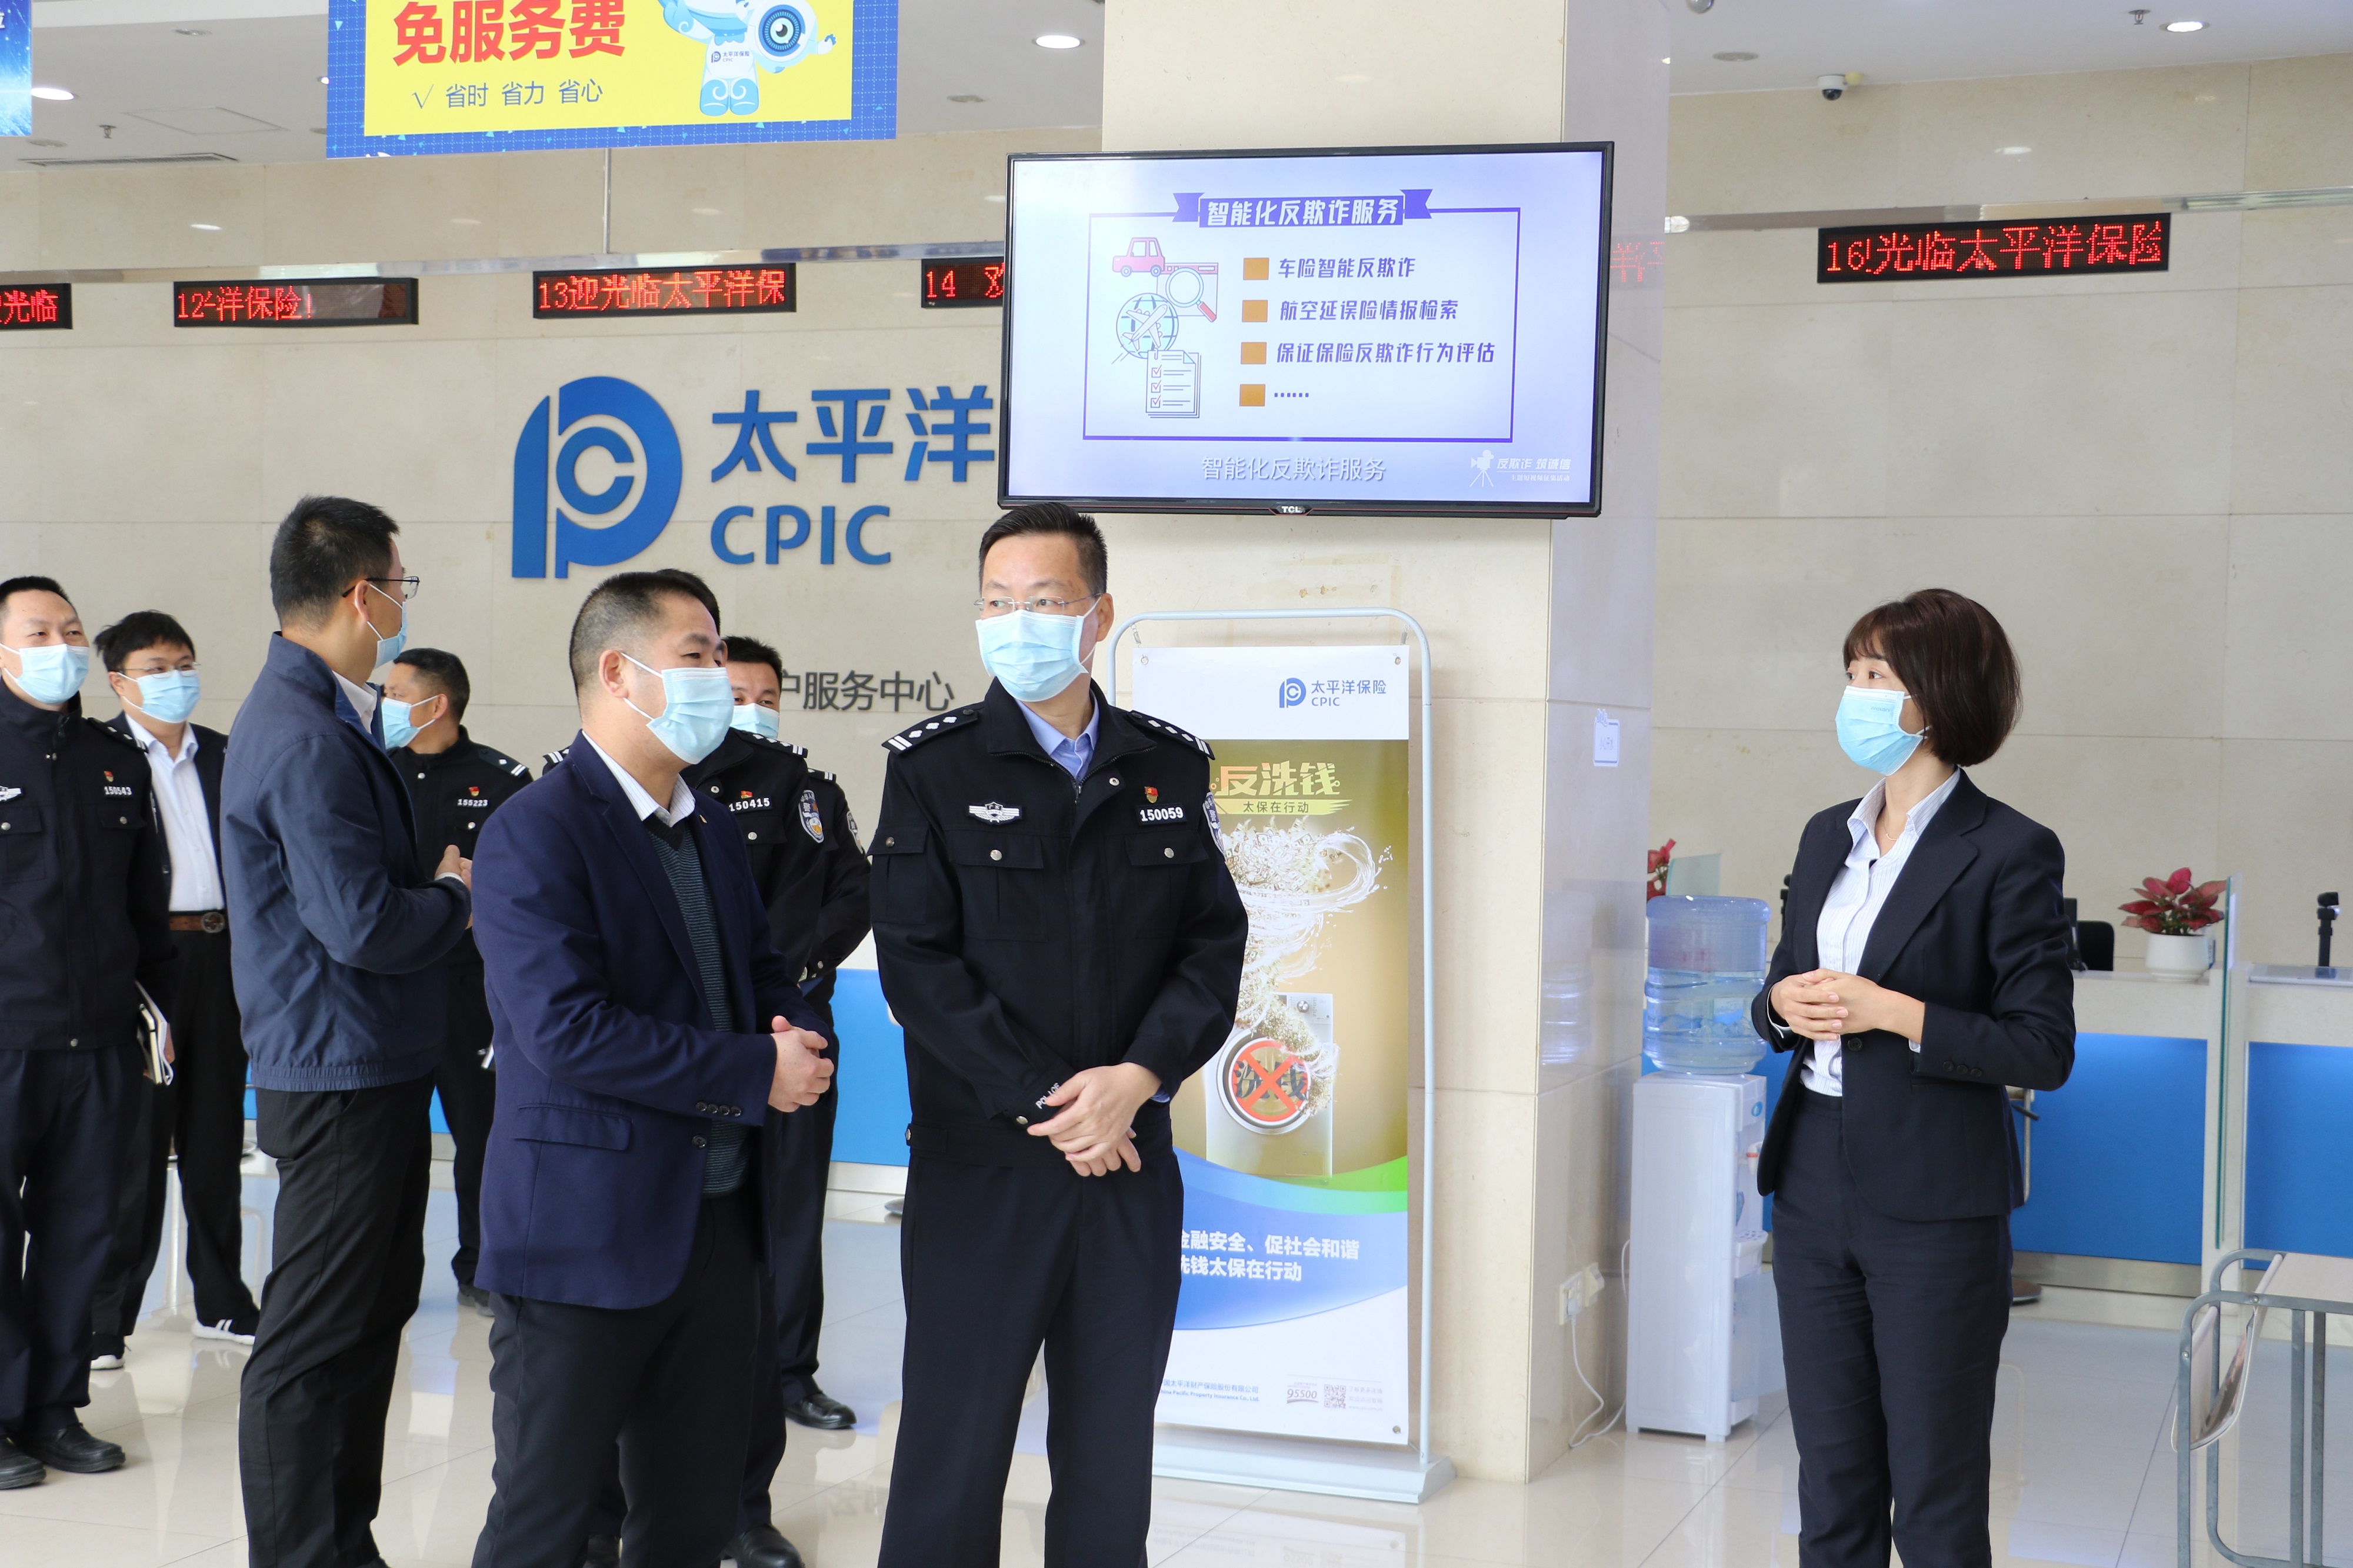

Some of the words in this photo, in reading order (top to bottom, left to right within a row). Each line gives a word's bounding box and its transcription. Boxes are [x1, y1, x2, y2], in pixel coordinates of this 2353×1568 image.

[393, 0, 626, 67] 免服务费
[445, 82, 489, 108] 省时
[501, 81, 544, 106] 省力
[558, 78, 604, 104] 省心
[1207, 198, 1399, 226] 智能化反欺诈服务
[1278, 256, 1417, 279] 车险智能反欺诈
[0, 289, 59, 325] 光临
[1280, 299, 1459, 321] 航空延误险情报检索
[1276, 342, 1497, 363] 保证保险反欺诈行为评估
[710, 384, 995, 483] 太平洋
[1200, 455, 1387, 481] 智能化反欺诈服务
[1497, 458, 1532, 469] 反欺诈
[1535, 458, 1572, 470] 筑诚信
[710, 505, 891, 565] CPIC
[1311, 680, 1387, 695] 太平洋保险
[1311, 697, 1340, 706] CPIC
[1214, 760, 1340, 796] 反洗钱
[104, 786, 132, 796] 150543
[457, 798, 488, 807] 155223
[728, 797, 771, 812] 150415
[1243, 801, 1309, 813] 太保在行动
[1139, 806, 1184, 822] 150059
[1287, 1389, 1317, 1399] 95500
